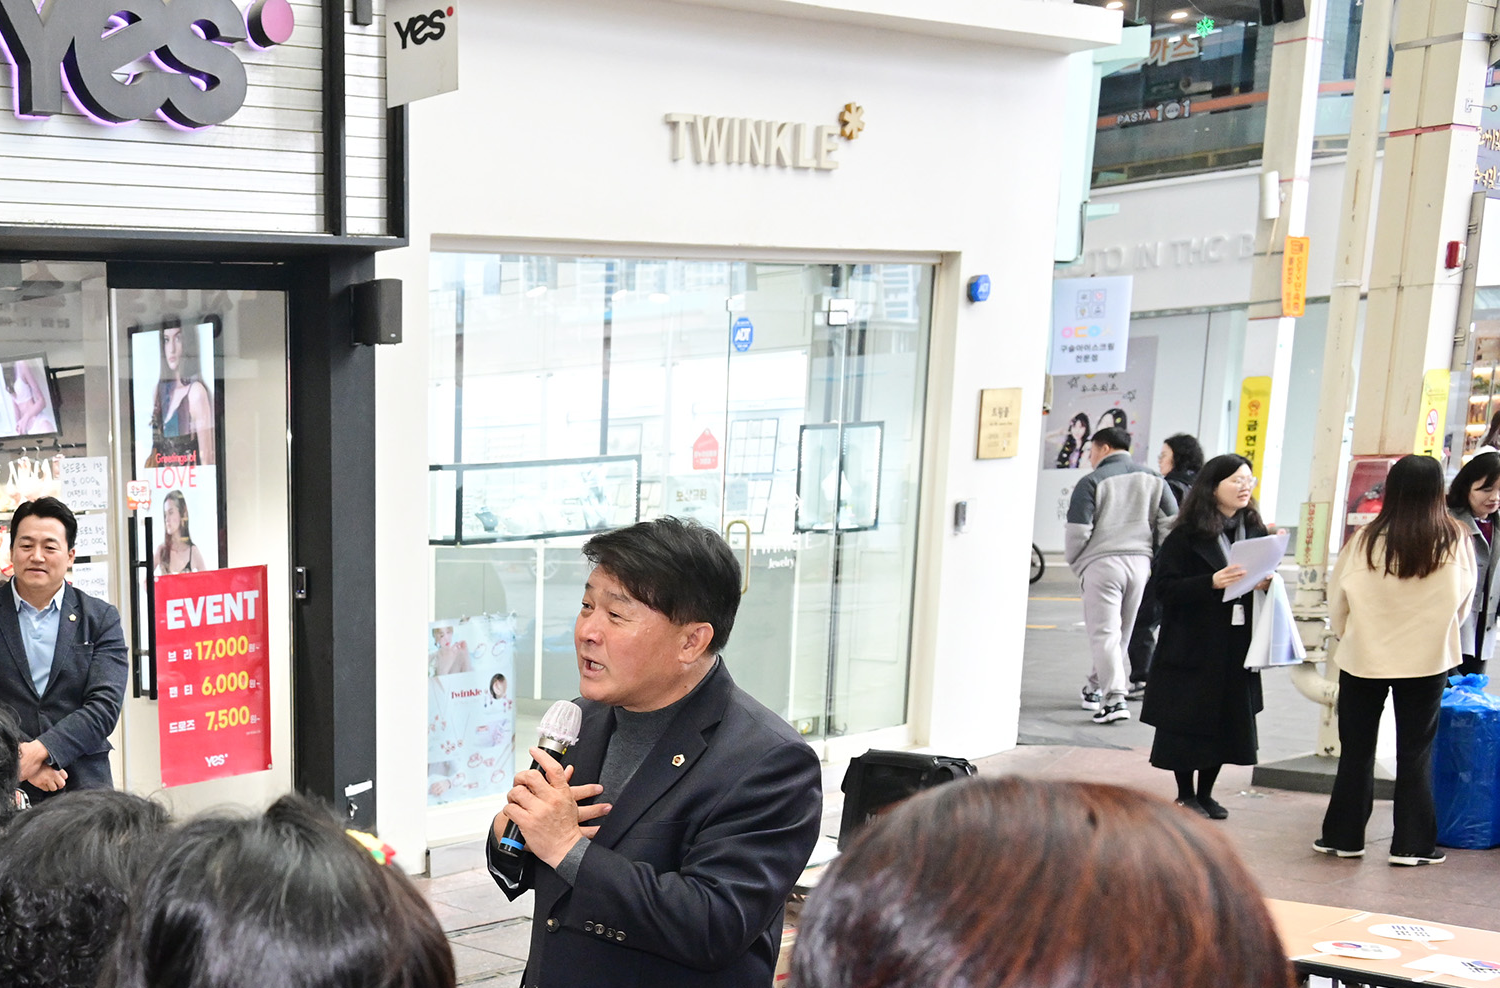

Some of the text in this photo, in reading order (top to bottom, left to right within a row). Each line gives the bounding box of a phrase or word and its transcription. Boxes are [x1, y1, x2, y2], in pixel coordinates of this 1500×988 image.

[1116, 109, 1152, 125] PASTA
[665, 112, 840, 171] TWINKLE
[155, 465, 197, 489] LOVE
[166, 589, 260, 631] EVENT
[169, 719, 196, 734] 드로즈
